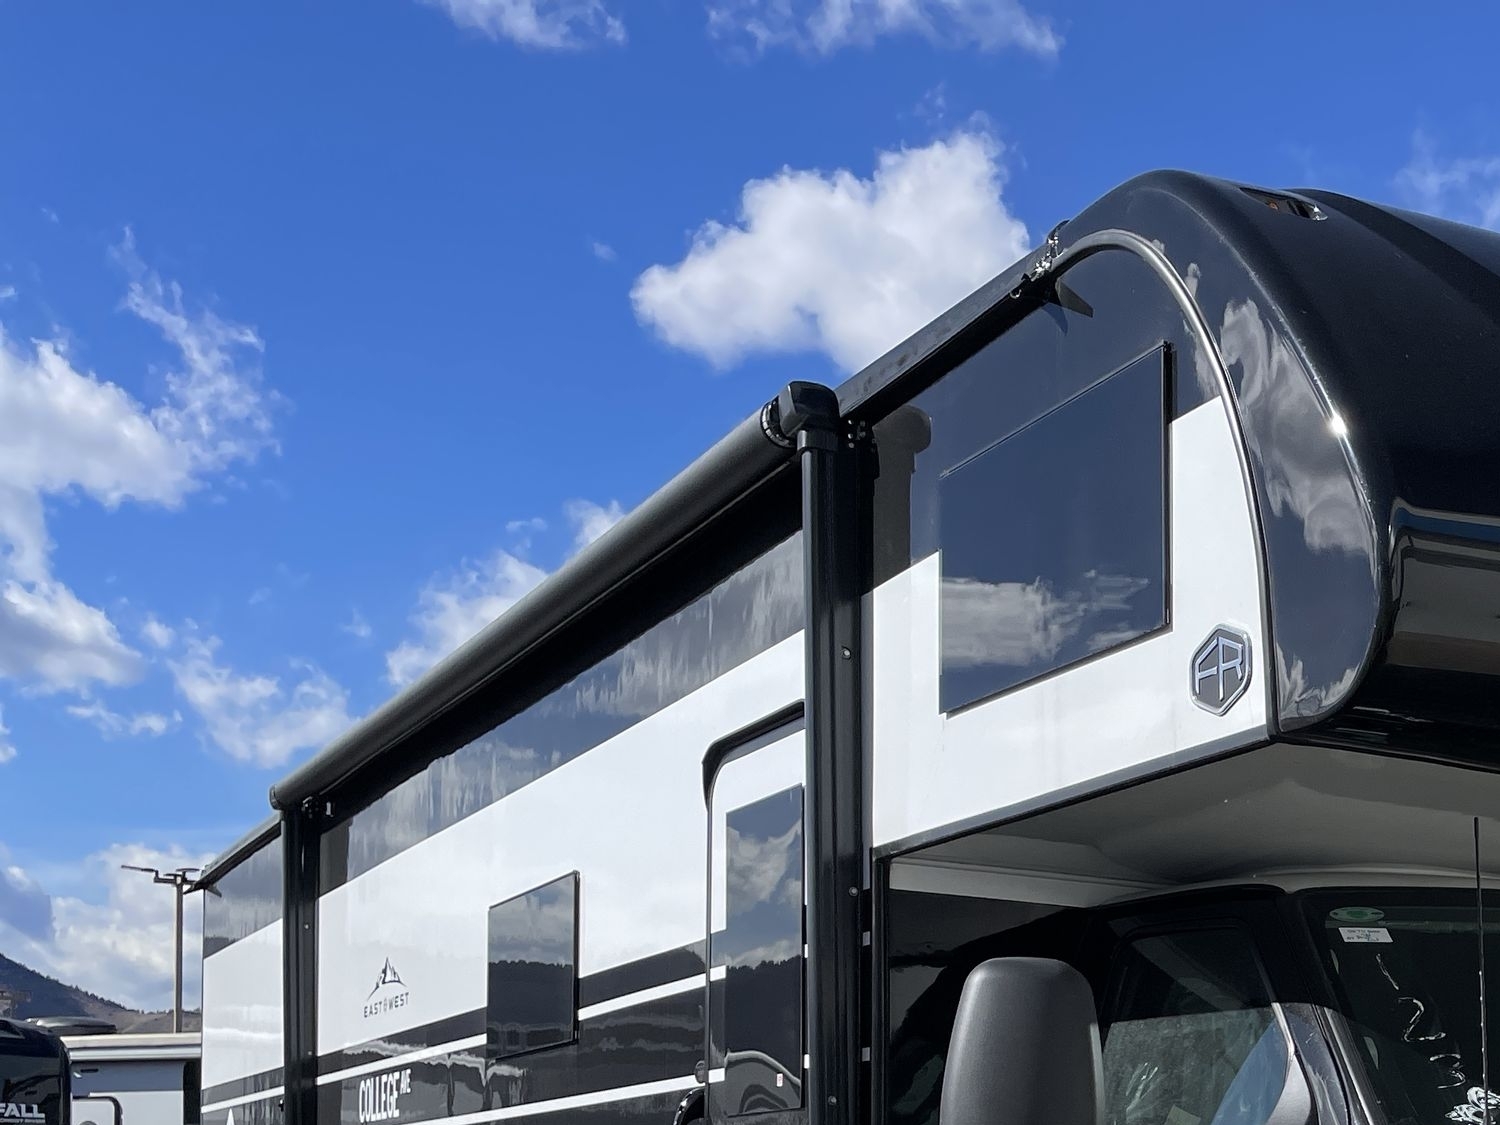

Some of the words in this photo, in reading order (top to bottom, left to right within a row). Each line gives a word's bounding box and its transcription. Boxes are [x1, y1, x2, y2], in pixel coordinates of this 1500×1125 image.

[363, 1001, 382, 1018] EAST
[388, 992, 409, 1010] WEST
[359, 1071, 400, 1123] COLLEGE
